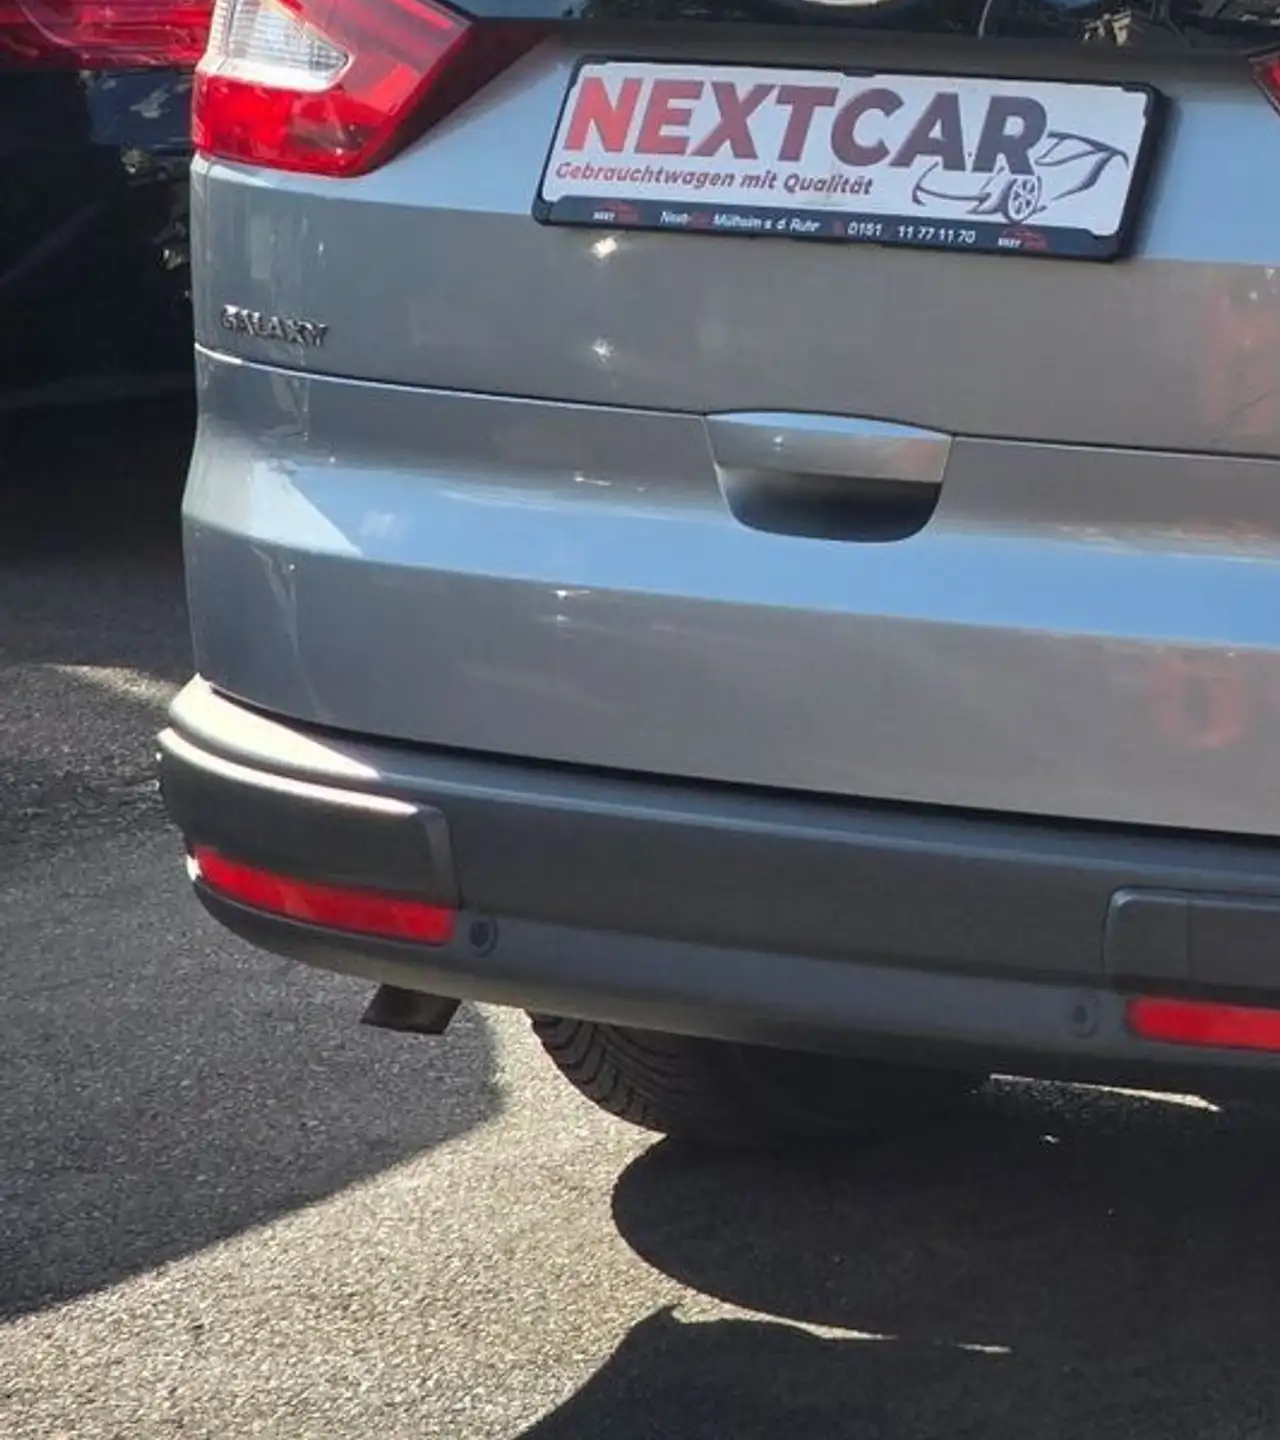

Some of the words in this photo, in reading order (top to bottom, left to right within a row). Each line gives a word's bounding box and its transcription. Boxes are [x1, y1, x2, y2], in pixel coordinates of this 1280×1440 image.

[563, 76, 1048, 175] NEXTCAR
[555, 162, 735, 189] Gebrauchtwagen
[740, 170, 777, 189] mit
[784, 173, 873, 195] Qualität
[847, 222, 882, 237] 0151
